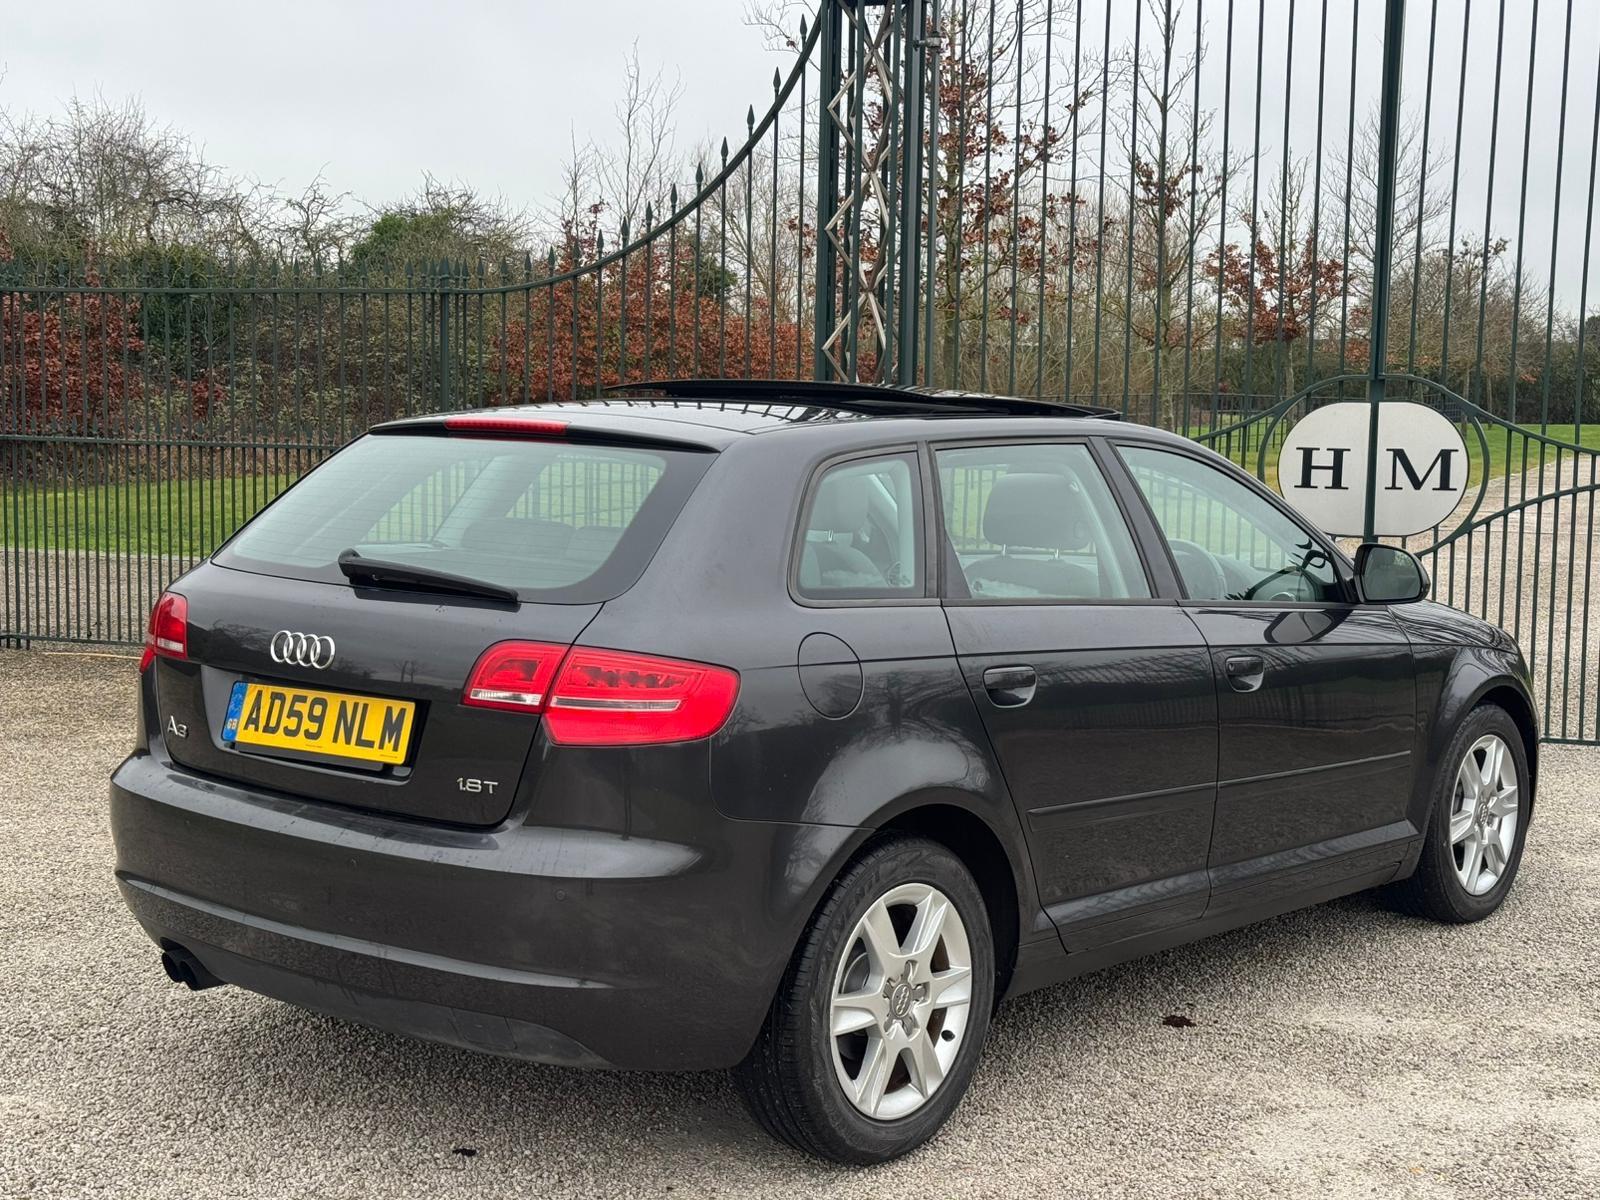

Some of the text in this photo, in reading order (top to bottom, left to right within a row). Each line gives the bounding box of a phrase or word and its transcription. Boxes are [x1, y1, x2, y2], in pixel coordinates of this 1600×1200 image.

[1293, 446, 1459, 491] H M
[167, 715, 187, 738] A3
[226, 718, 238, 730] GB
[243, 689, 407, 752] AD59 NLM
